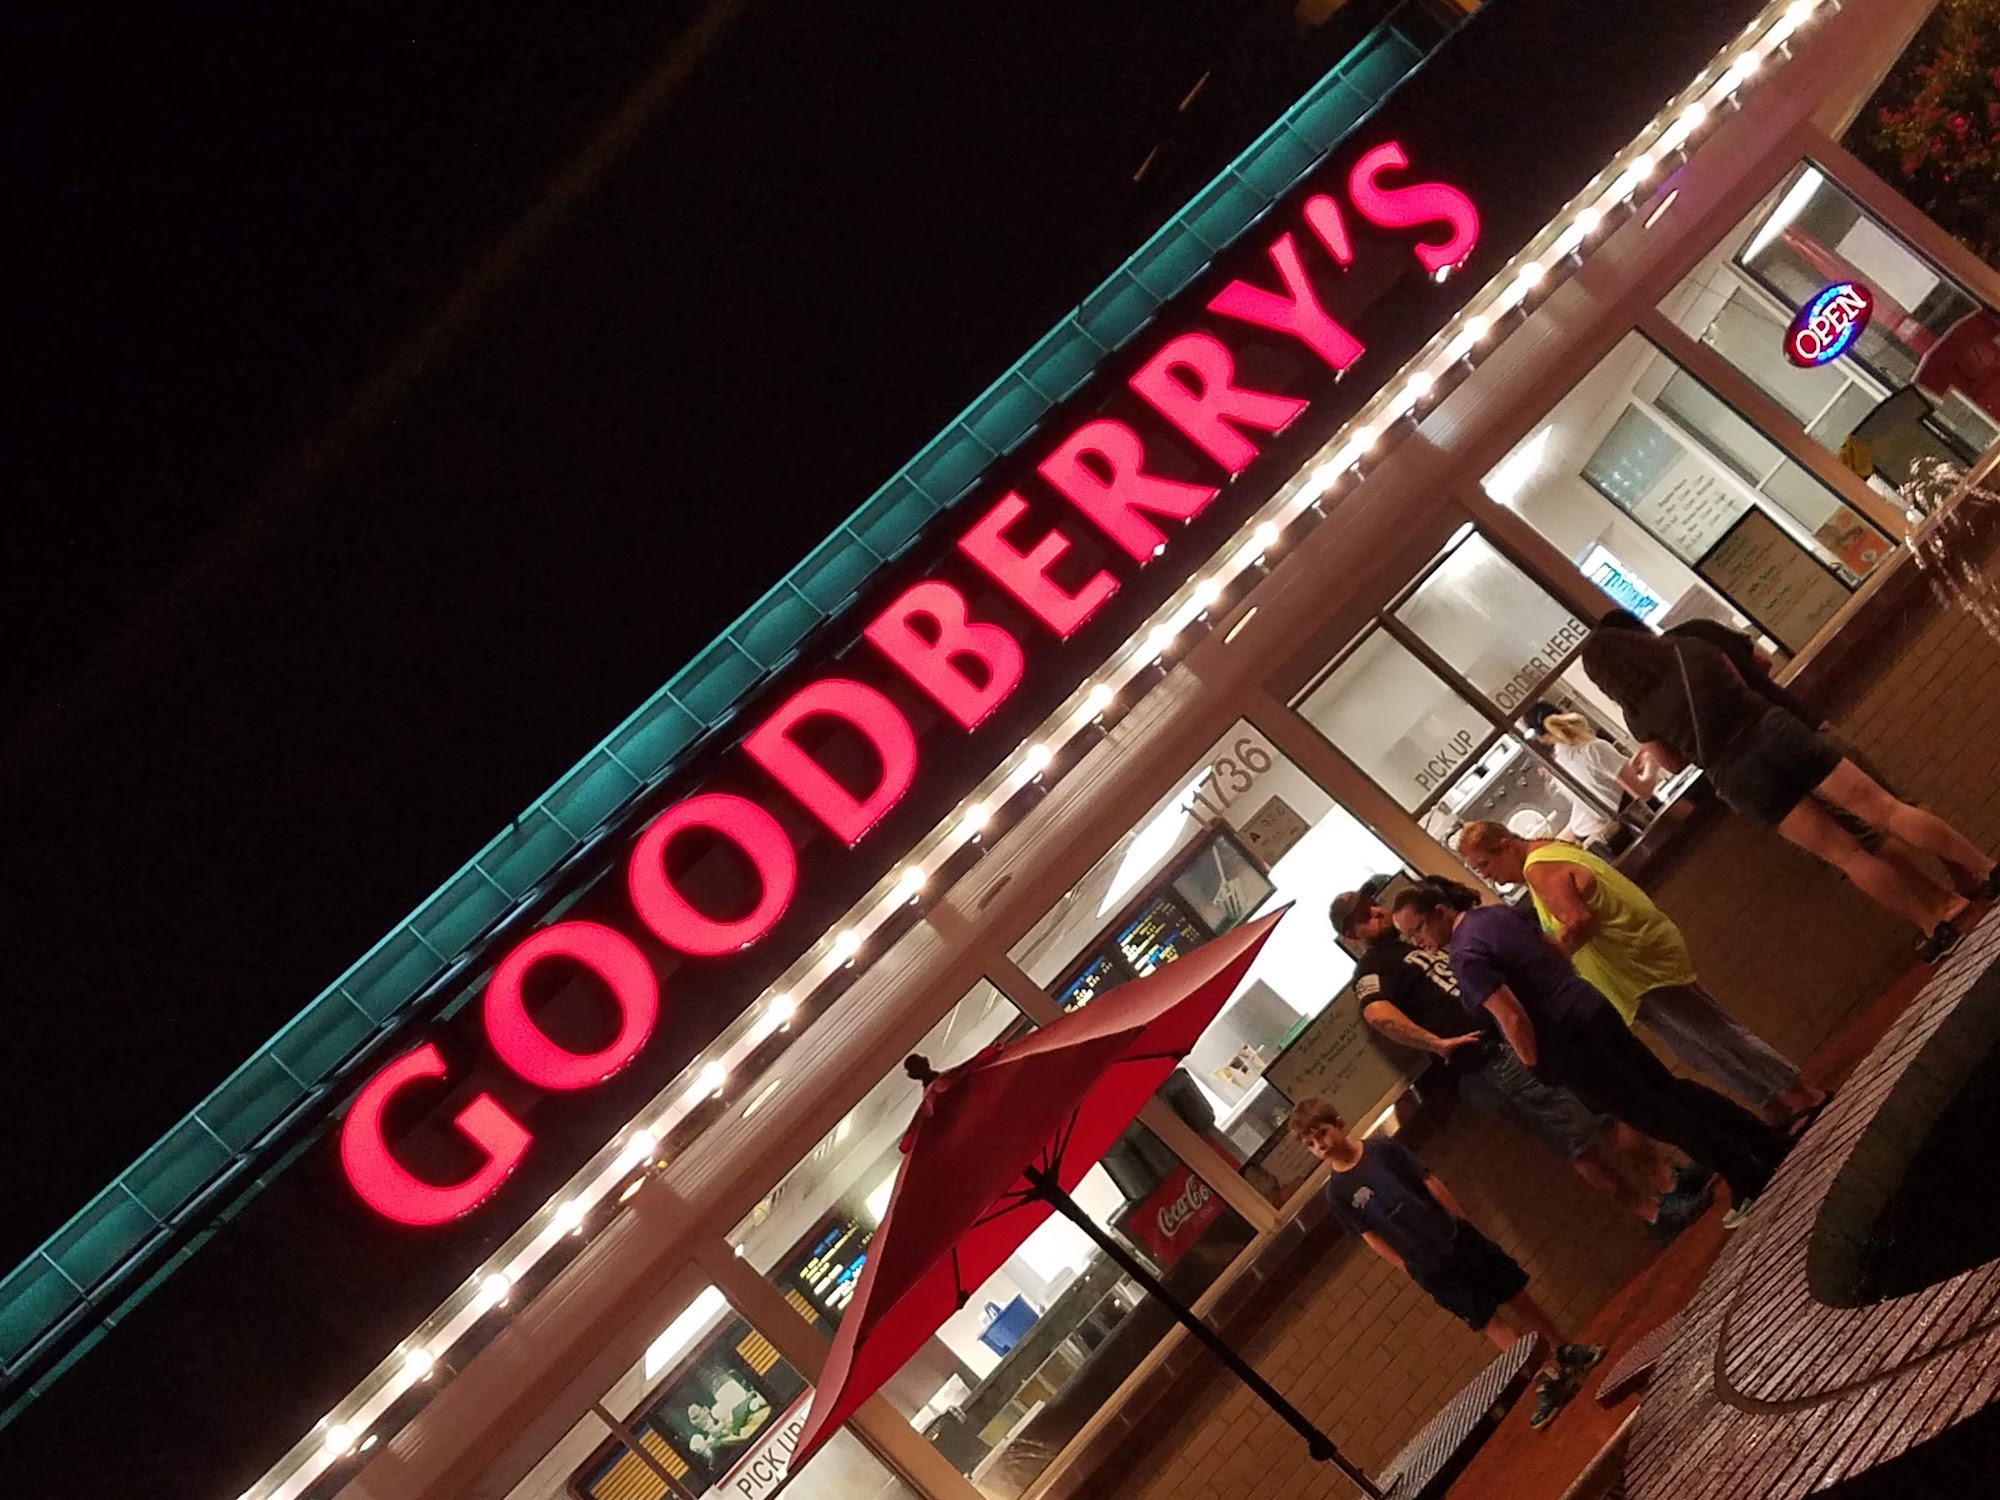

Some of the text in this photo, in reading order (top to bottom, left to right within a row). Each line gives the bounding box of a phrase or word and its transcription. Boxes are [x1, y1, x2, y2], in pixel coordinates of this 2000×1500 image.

[1796, 284, 1867, 359] OPEN
[339, 139, 1480, 1227] GOODBERRY'S
[1495, 618, 1588, 710] ORDER HERE
[1180, 738, 1272, 831] 11736
[1415, 729, 1476, 792] PICK UP
[1158, 1174, 1212, 1237] Coca-Co
[736, 1447, 786, 1500] PICK
